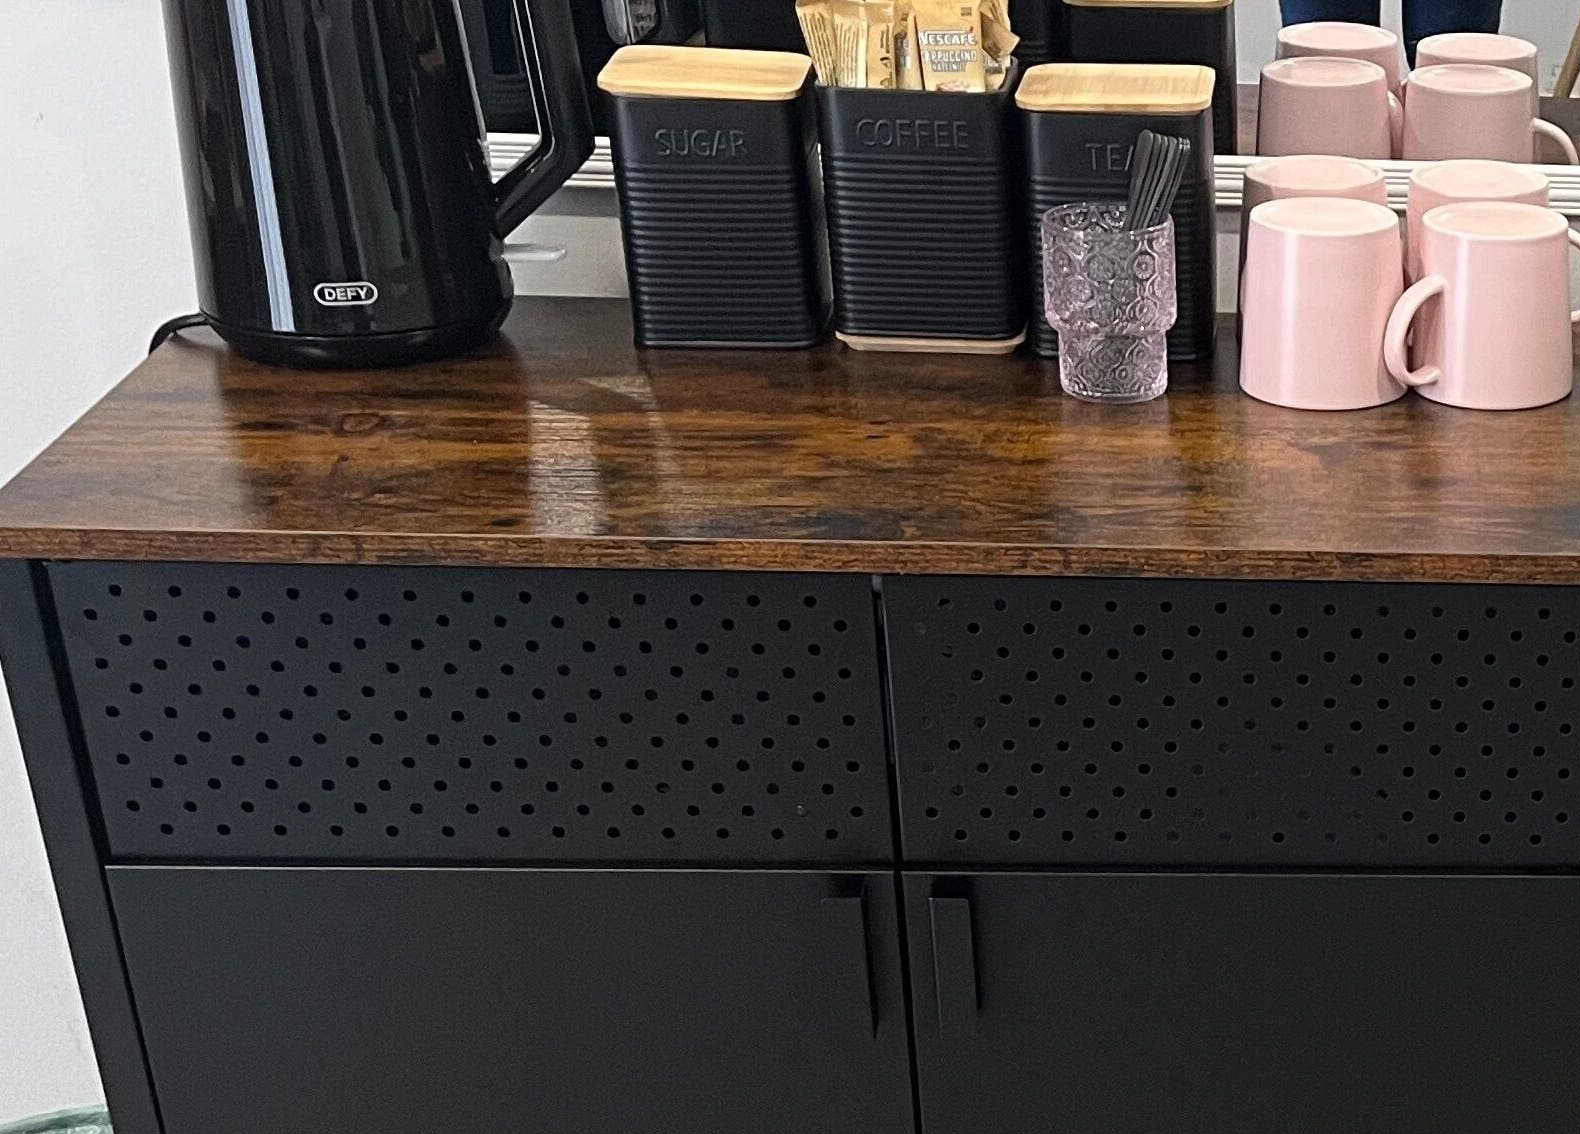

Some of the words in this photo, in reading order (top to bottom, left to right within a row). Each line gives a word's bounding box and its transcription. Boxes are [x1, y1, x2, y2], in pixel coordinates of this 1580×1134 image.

[654, 127, 747, 157] SUGAR
[856, 118, 969, 149] COFFEE
[323, 286, 368, 301] DEFY
